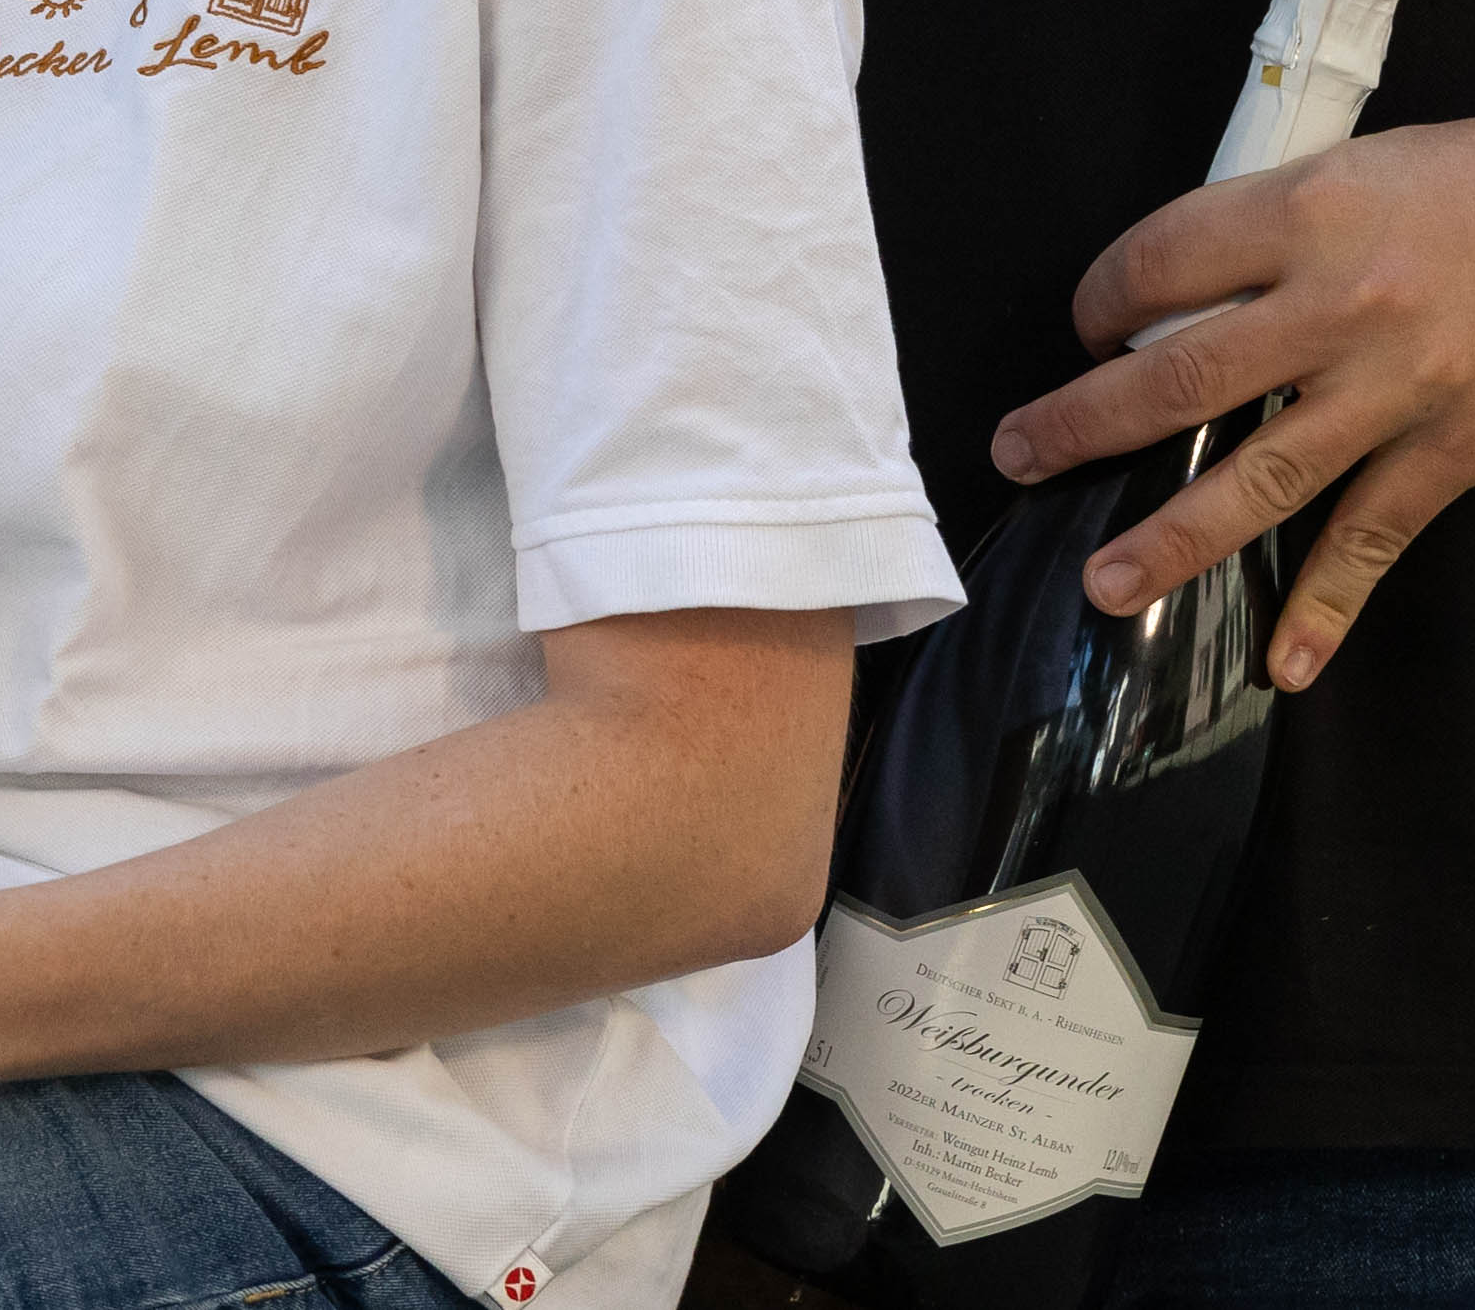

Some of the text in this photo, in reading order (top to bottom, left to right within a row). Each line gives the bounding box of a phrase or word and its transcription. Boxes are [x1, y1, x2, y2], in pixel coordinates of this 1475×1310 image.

[137, 14, 330, 78] Lemb
[876, 988, 1125, 1101] Weißburgunder
[951, 1077, 1034, 1114] trocken
[912, 1139, 1024, 1188] Inh.: Martin Becker
[943, 1130, 990, 1158] Weingut
[991, 1149, 1027, 1171] Heinz
[1028, 1160, 1058, 1180] Lemb
